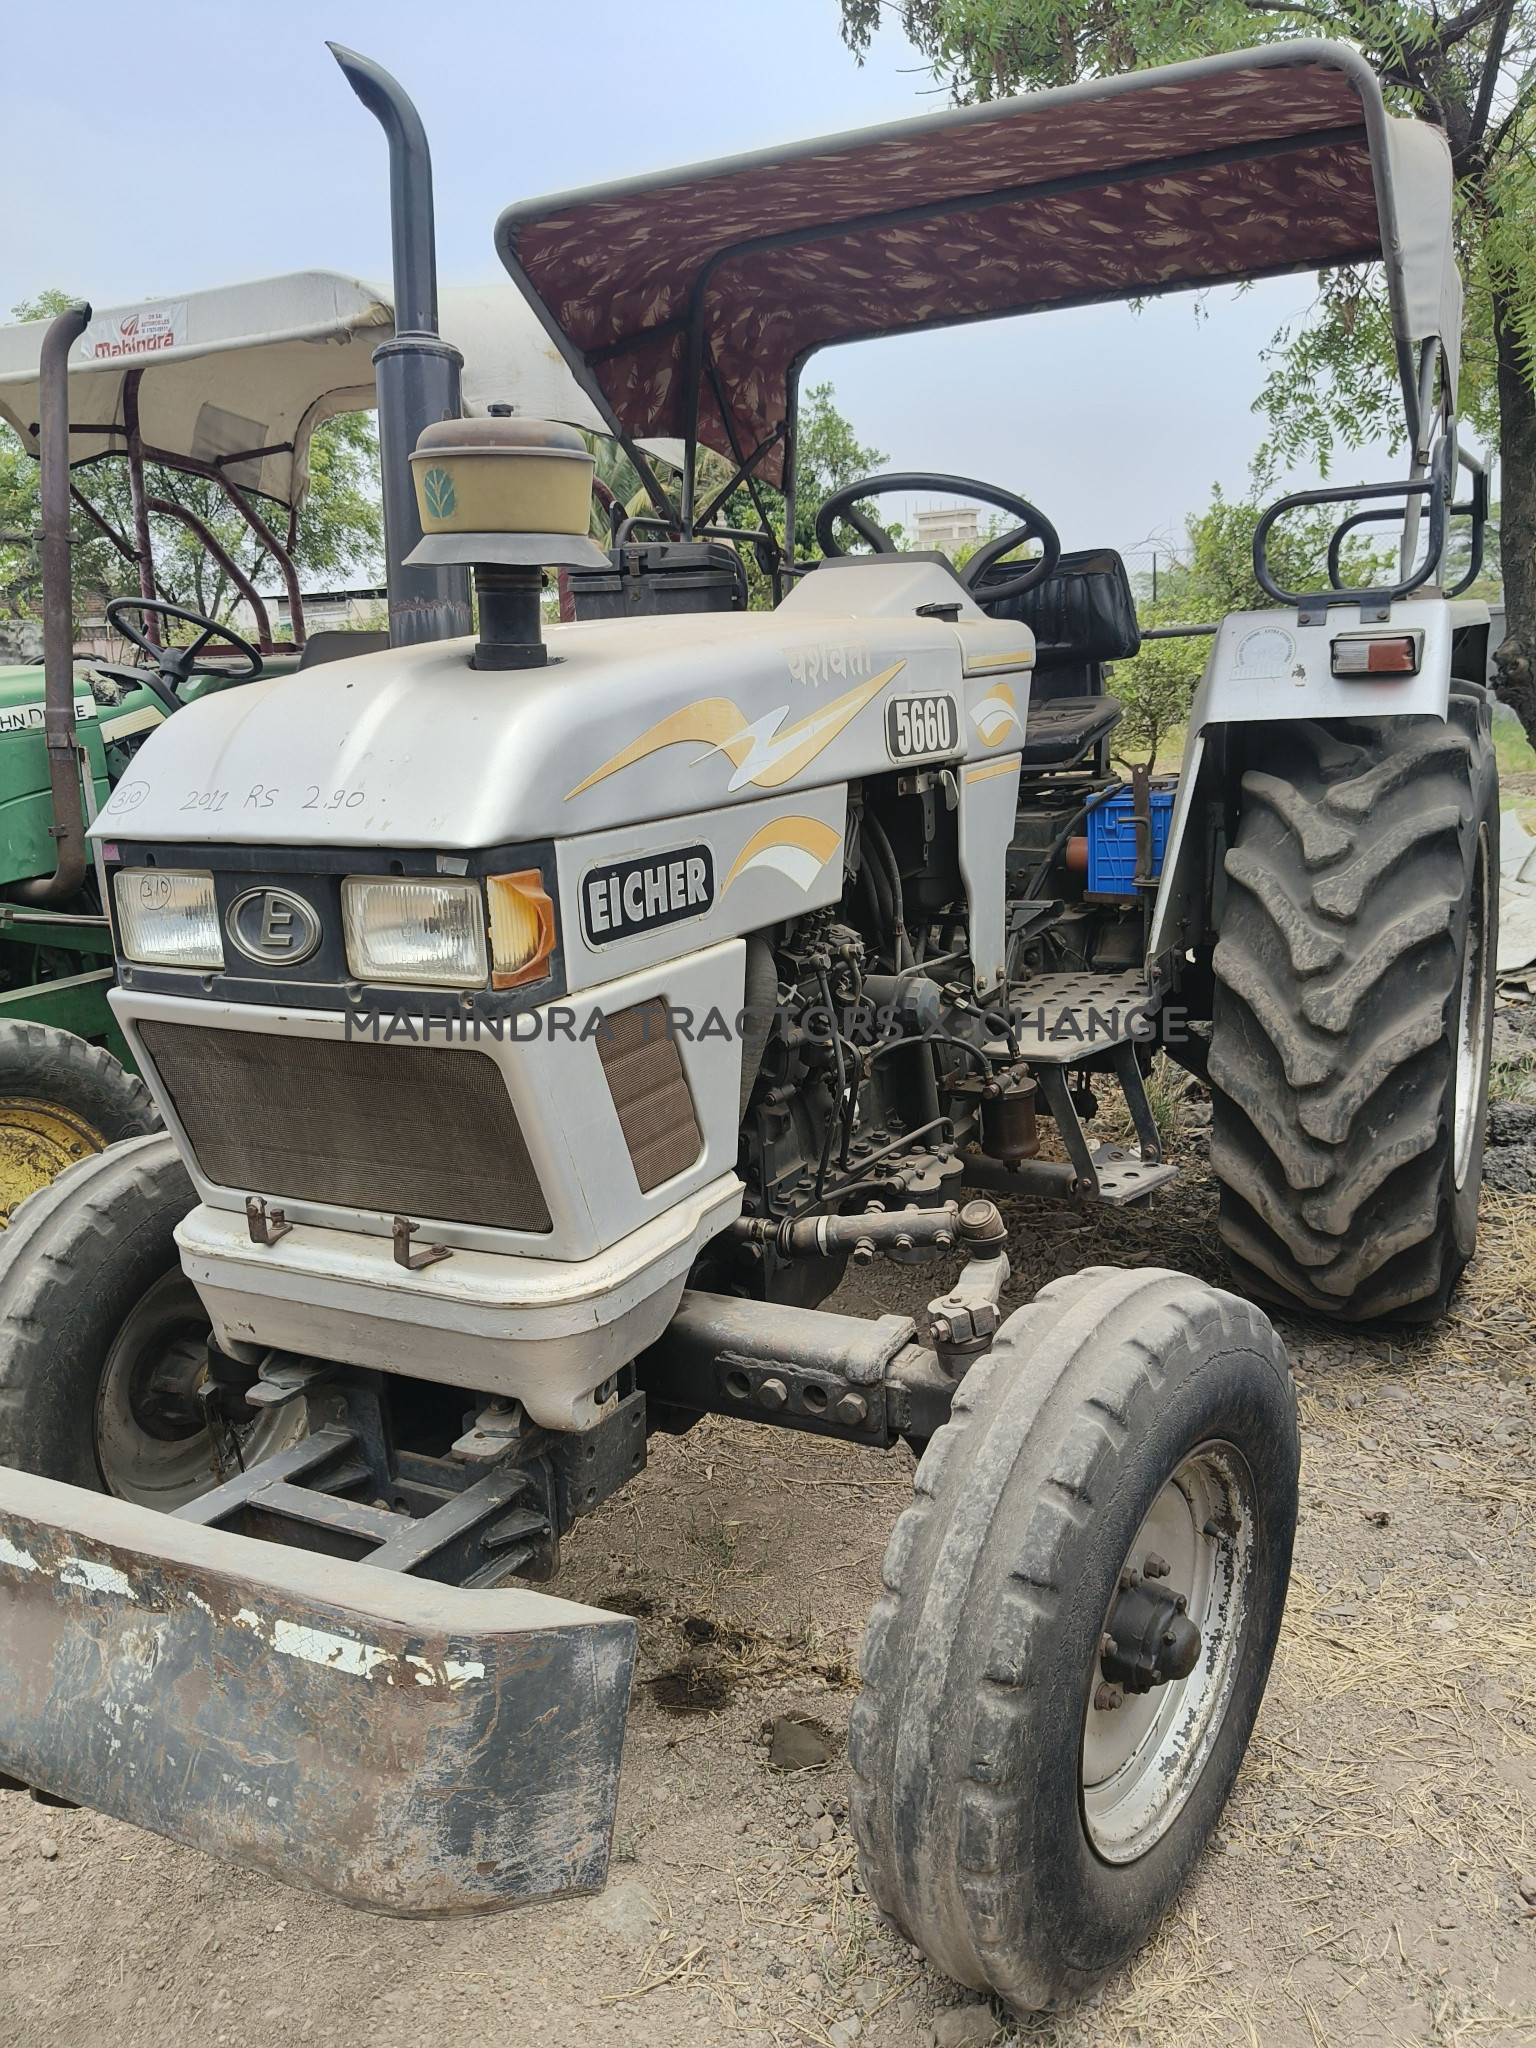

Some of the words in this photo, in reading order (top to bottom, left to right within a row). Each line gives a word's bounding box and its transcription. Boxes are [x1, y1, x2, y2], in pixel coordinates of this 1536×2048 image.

[95, 332, 174, 358] Mahindra
[896, 698, 950, 755] 5660
[111, 791, 143, 809] 310
[179, 791, 229, 811] 2011
[243, 784, 279, 808] RS
[588, 856, 709, 934] EICHER
